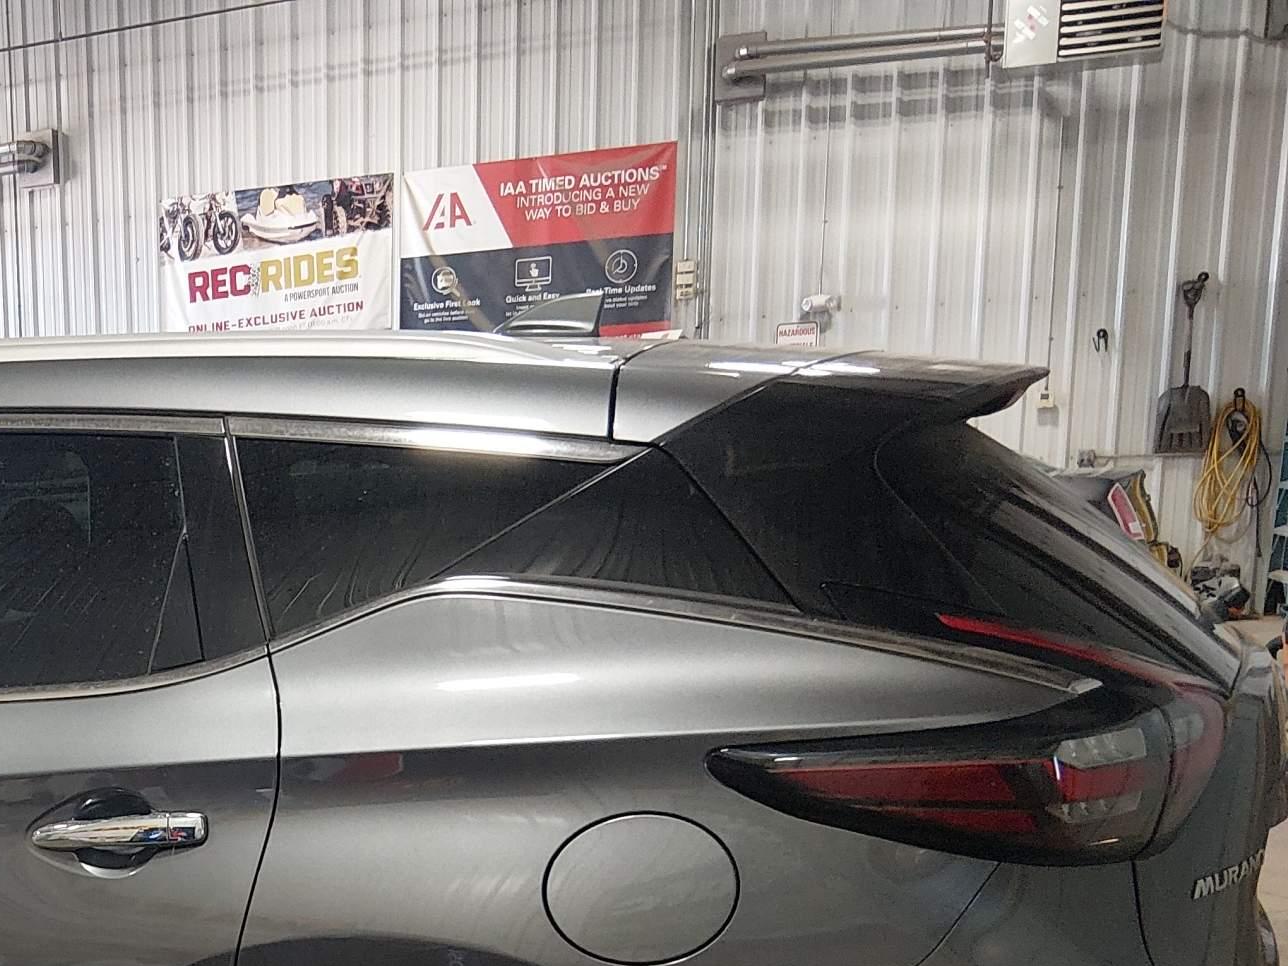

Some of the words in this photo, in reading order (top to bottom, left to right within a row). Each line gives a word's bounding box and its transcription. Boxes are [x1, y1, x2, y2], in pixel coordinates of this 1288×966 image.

[500, 180, 526, 197] IAA
[529, 176, 576, 194] TIMED
[516, 187, 602, 208] INTRODUCING
[605, 187, 615, 199] A
[619, 183, 650, 197] NEW
[525, 209, 552, 221] WAY
[555, 206, 572, 217] TO
[576, 202, 597, 216] BID
[600, 201, 610, 213] &
[614, 198, 641, 212] BUY
[188, 263, 251, 304] REC
[260, 246, 359, 294] RIDES
[284, 293, 289, 303] A
[290, 288, 330, 302] POWERSPORT
[332, 283, 359, 295] AUCTION
[505, 294, 527, 304] Quick
[527, 293, 541, 302] and
[543, 291, 560, 300] Easy
[604, 286, 623, 295] Time
[624, 284, 657, 294] Updates
[309, 300, 365, 319] AUCTION
[413, 300, 445, 311] Exclusive
[445, 298, 461, 309] First
[778, 326, 816, 337] HAZARDOUS
